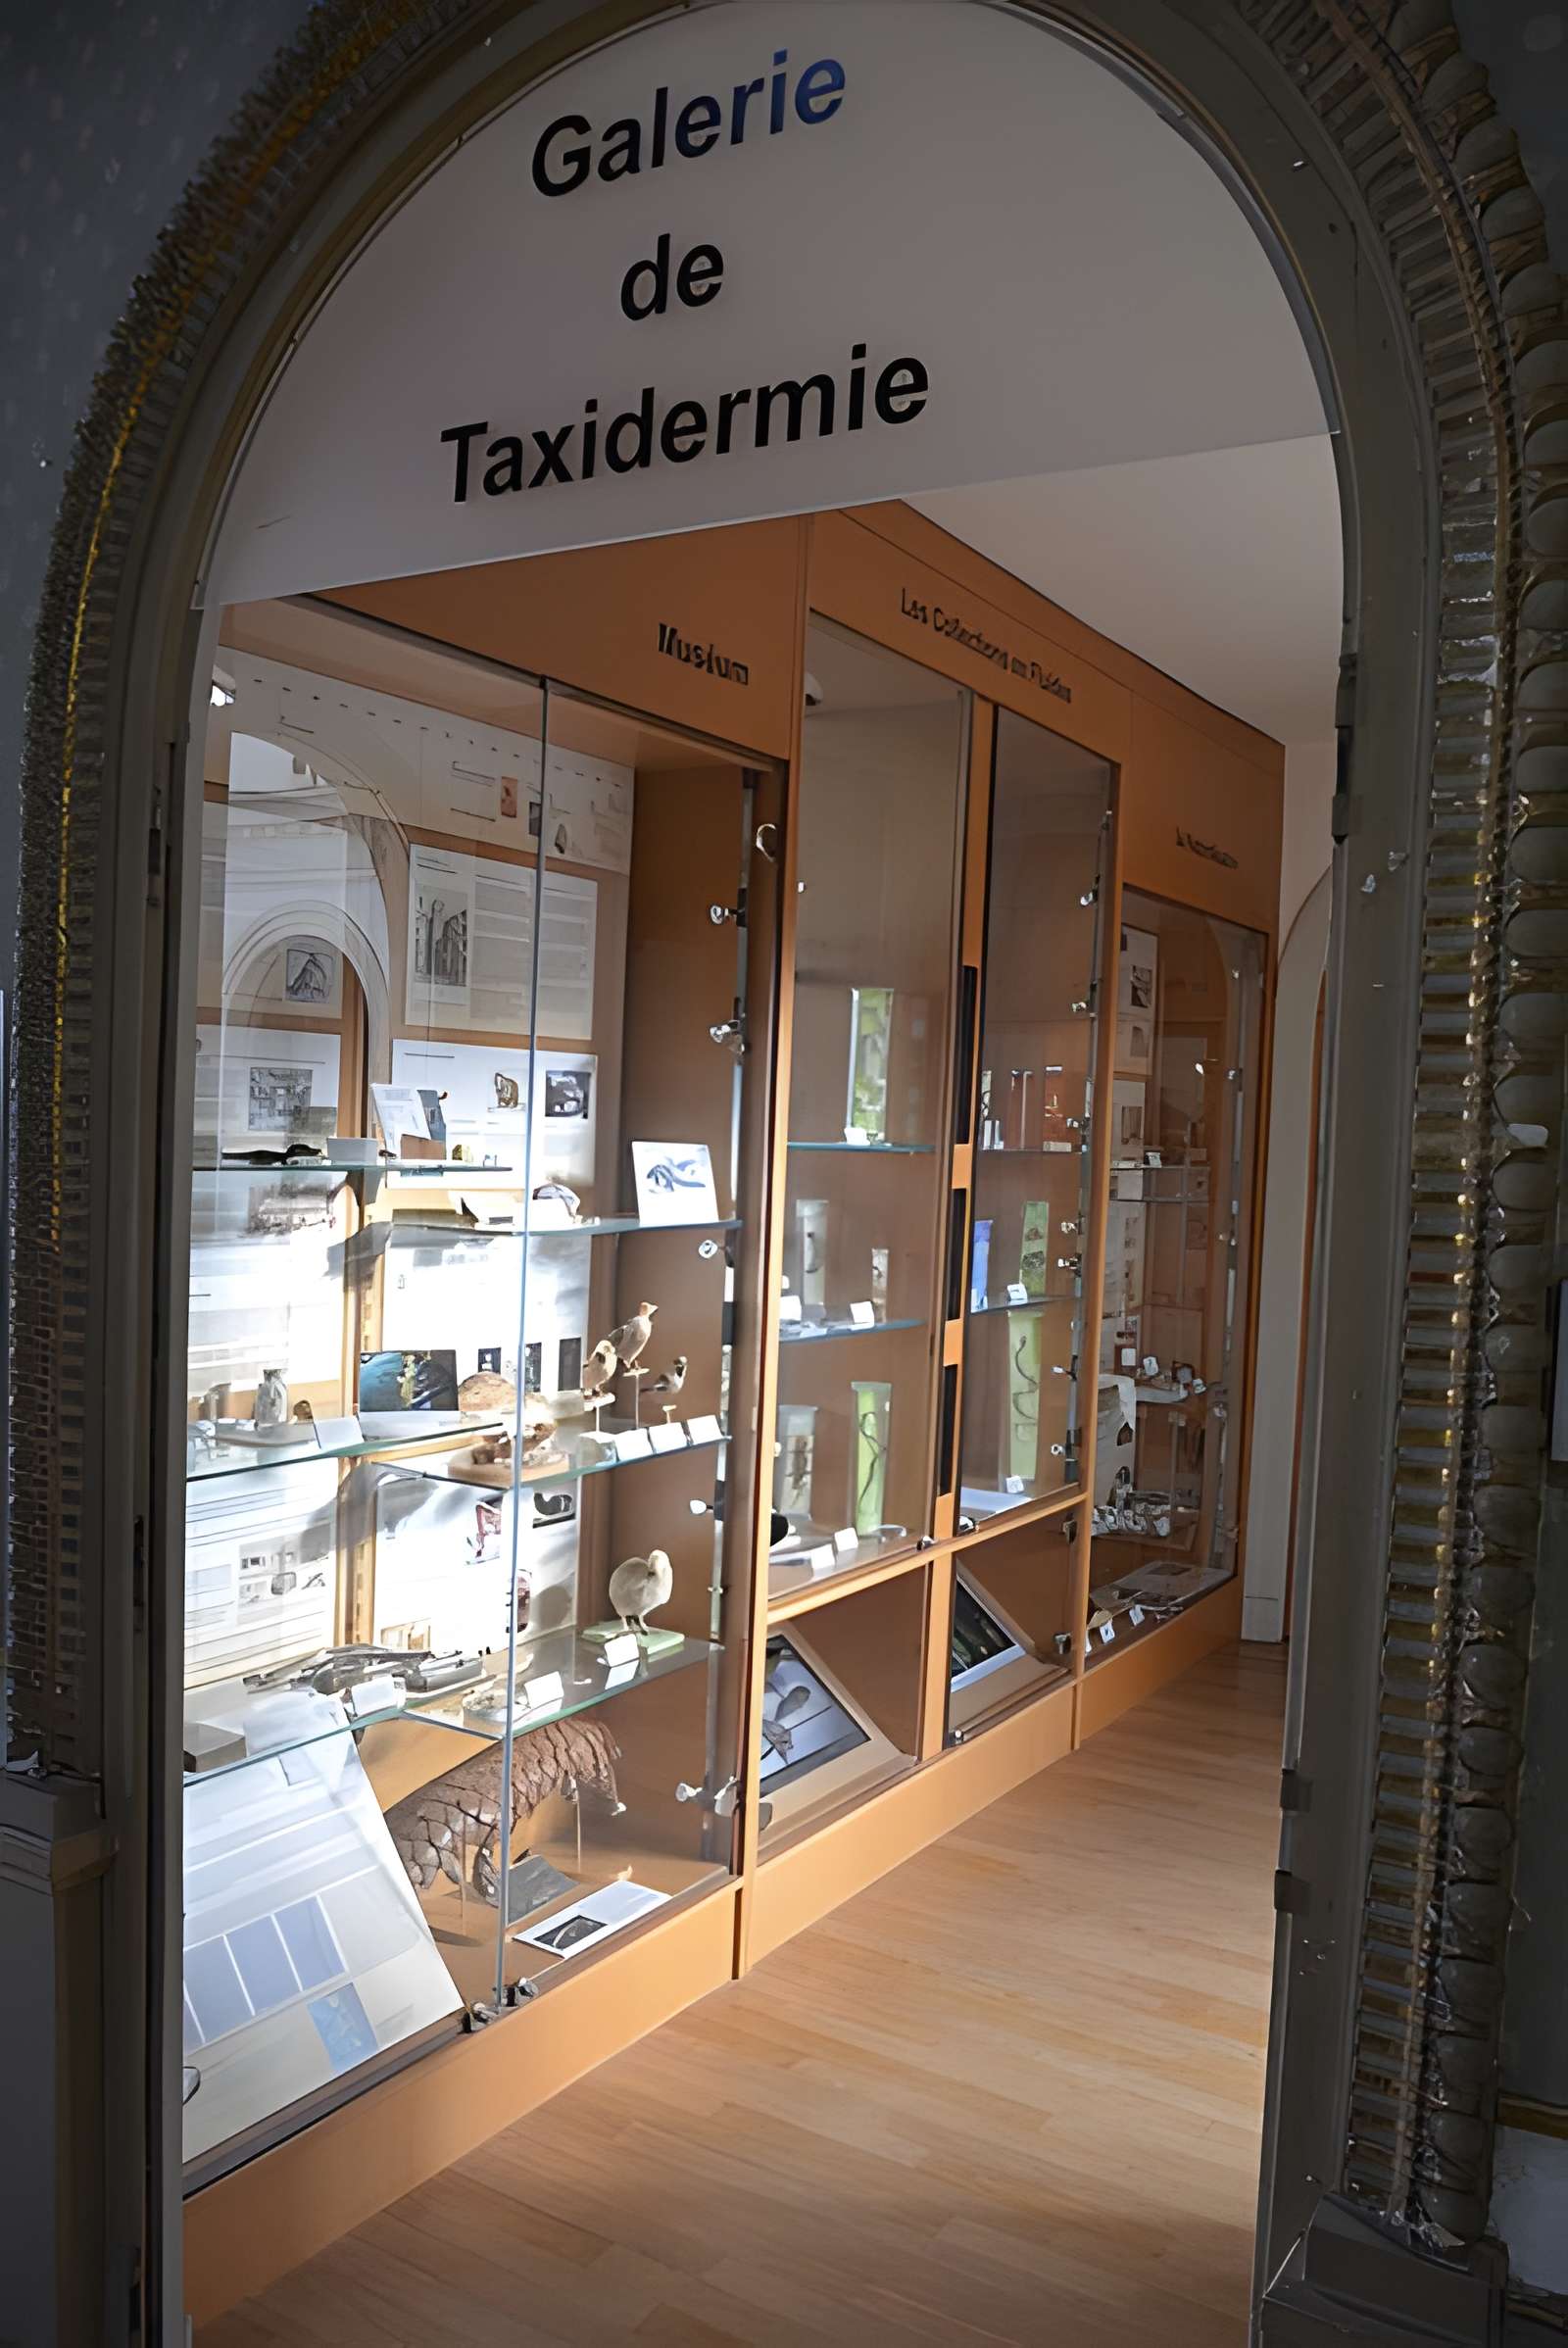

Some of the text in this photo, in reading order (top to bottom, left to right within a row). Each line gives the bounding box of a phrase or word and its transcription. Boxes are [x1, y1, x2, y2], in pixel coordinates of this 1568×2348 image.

[532, 49, 846, 197] Galerie
[620, 233, 723, 320] de
[440, 343, 928, 503] Taxidermie
